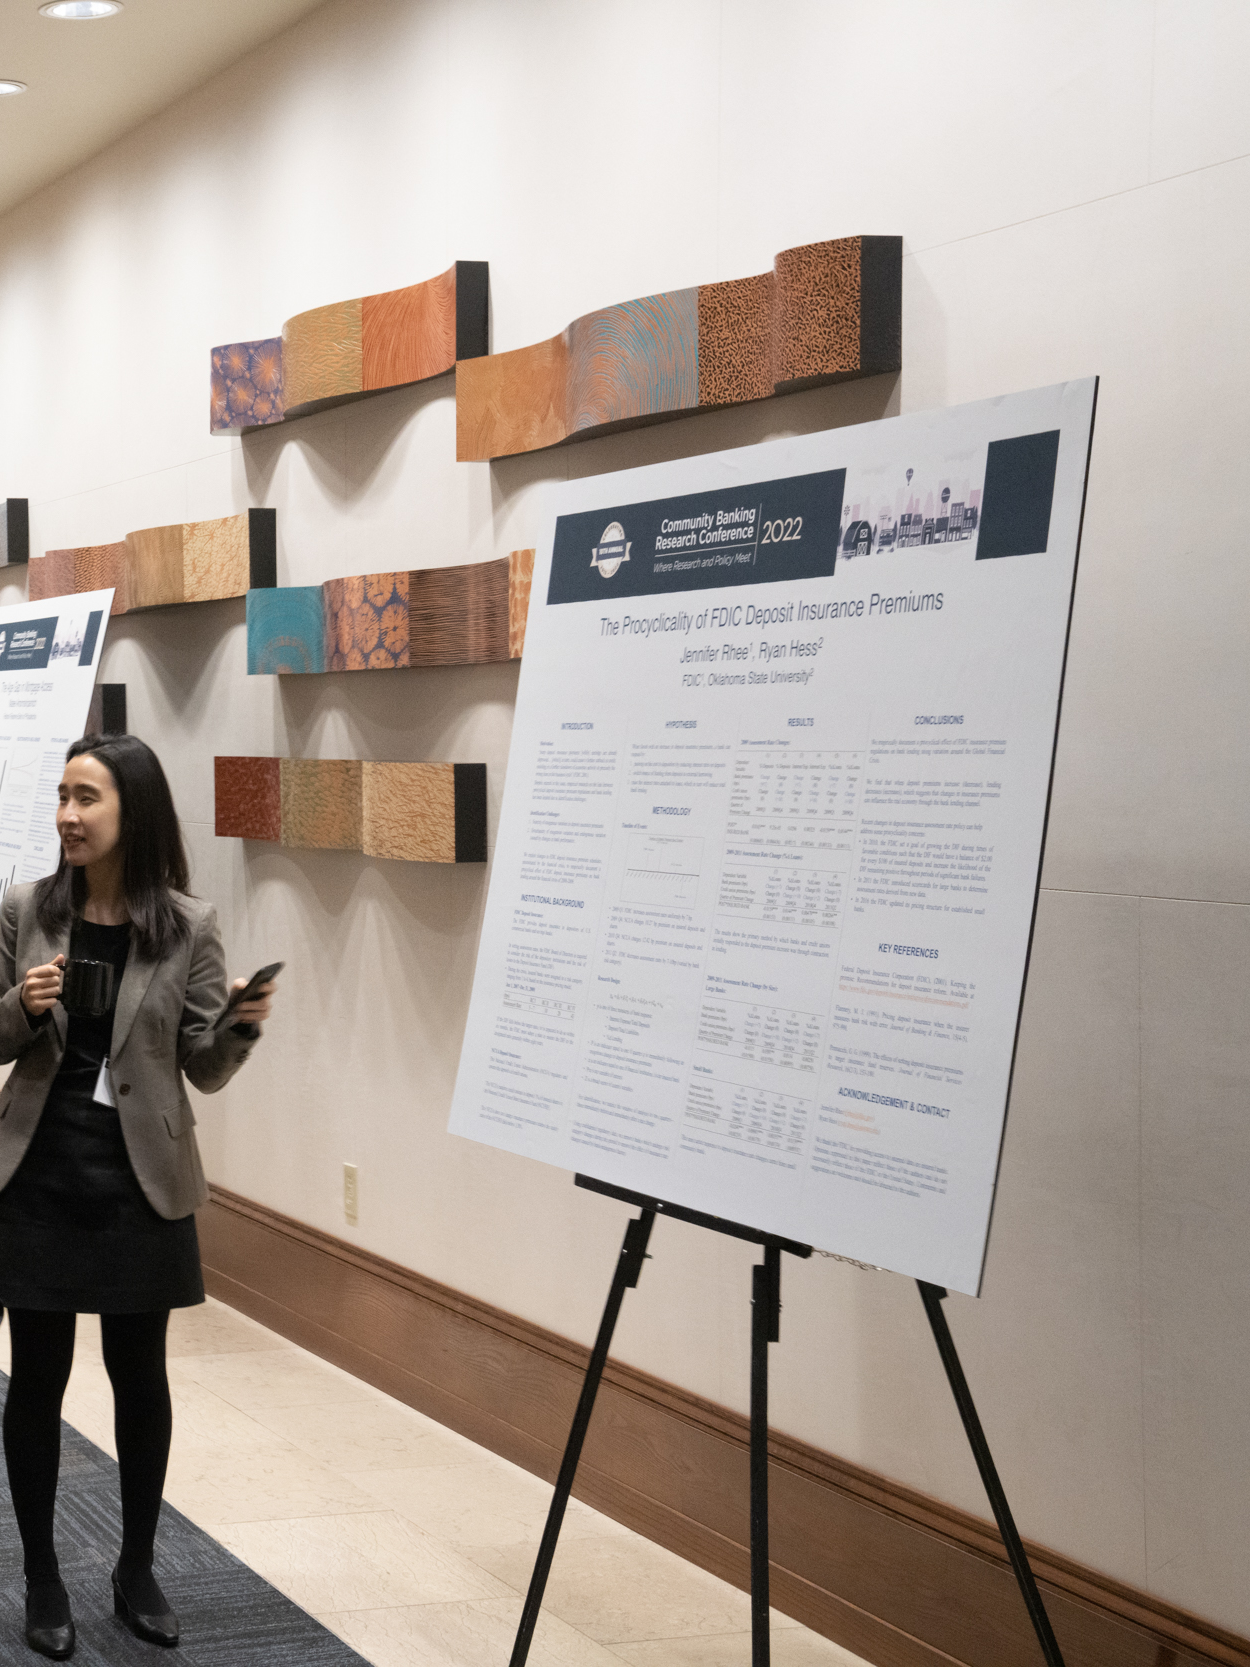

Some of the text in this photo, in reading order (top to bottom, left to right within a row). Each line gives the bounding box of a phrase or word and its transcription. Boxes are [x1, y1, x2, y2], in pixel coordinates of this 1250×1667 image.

[661, 507, 756, 534] Community Banking
[655, 524, 754, 550] Research Conference
[760, 516, 803, 545] 2022
[653, 551, 752, 573] Where Research and Policy Meet
[600, 590, 944, 638] The Procyclicality of FDIC Deposit Insurance Premiums
[679, 645, 719, 664] Jennifer
[758, 641, 787, 662] Ryan
[707, 671, 746, 687] Oklahoma
[747, 670, 768, 685] State
[560, 721, 593, 730] INTRODUCTION
[664, 719, 697, 729] HYPOTHESIS
[787, 717, 814, 727] RESULTS
[913, 714, 964, 725] CONCLUSIONS
[651, 806, 691, 816] METHODOLOGY
[520, 893, 584, 909] INSTITUTIONAL BACKGROUND
[877, 942, 939, 959] KEY REFERENCES
[837, 1086, 951, 1118] ACKNOWLEDGEMENT & CONTACT
